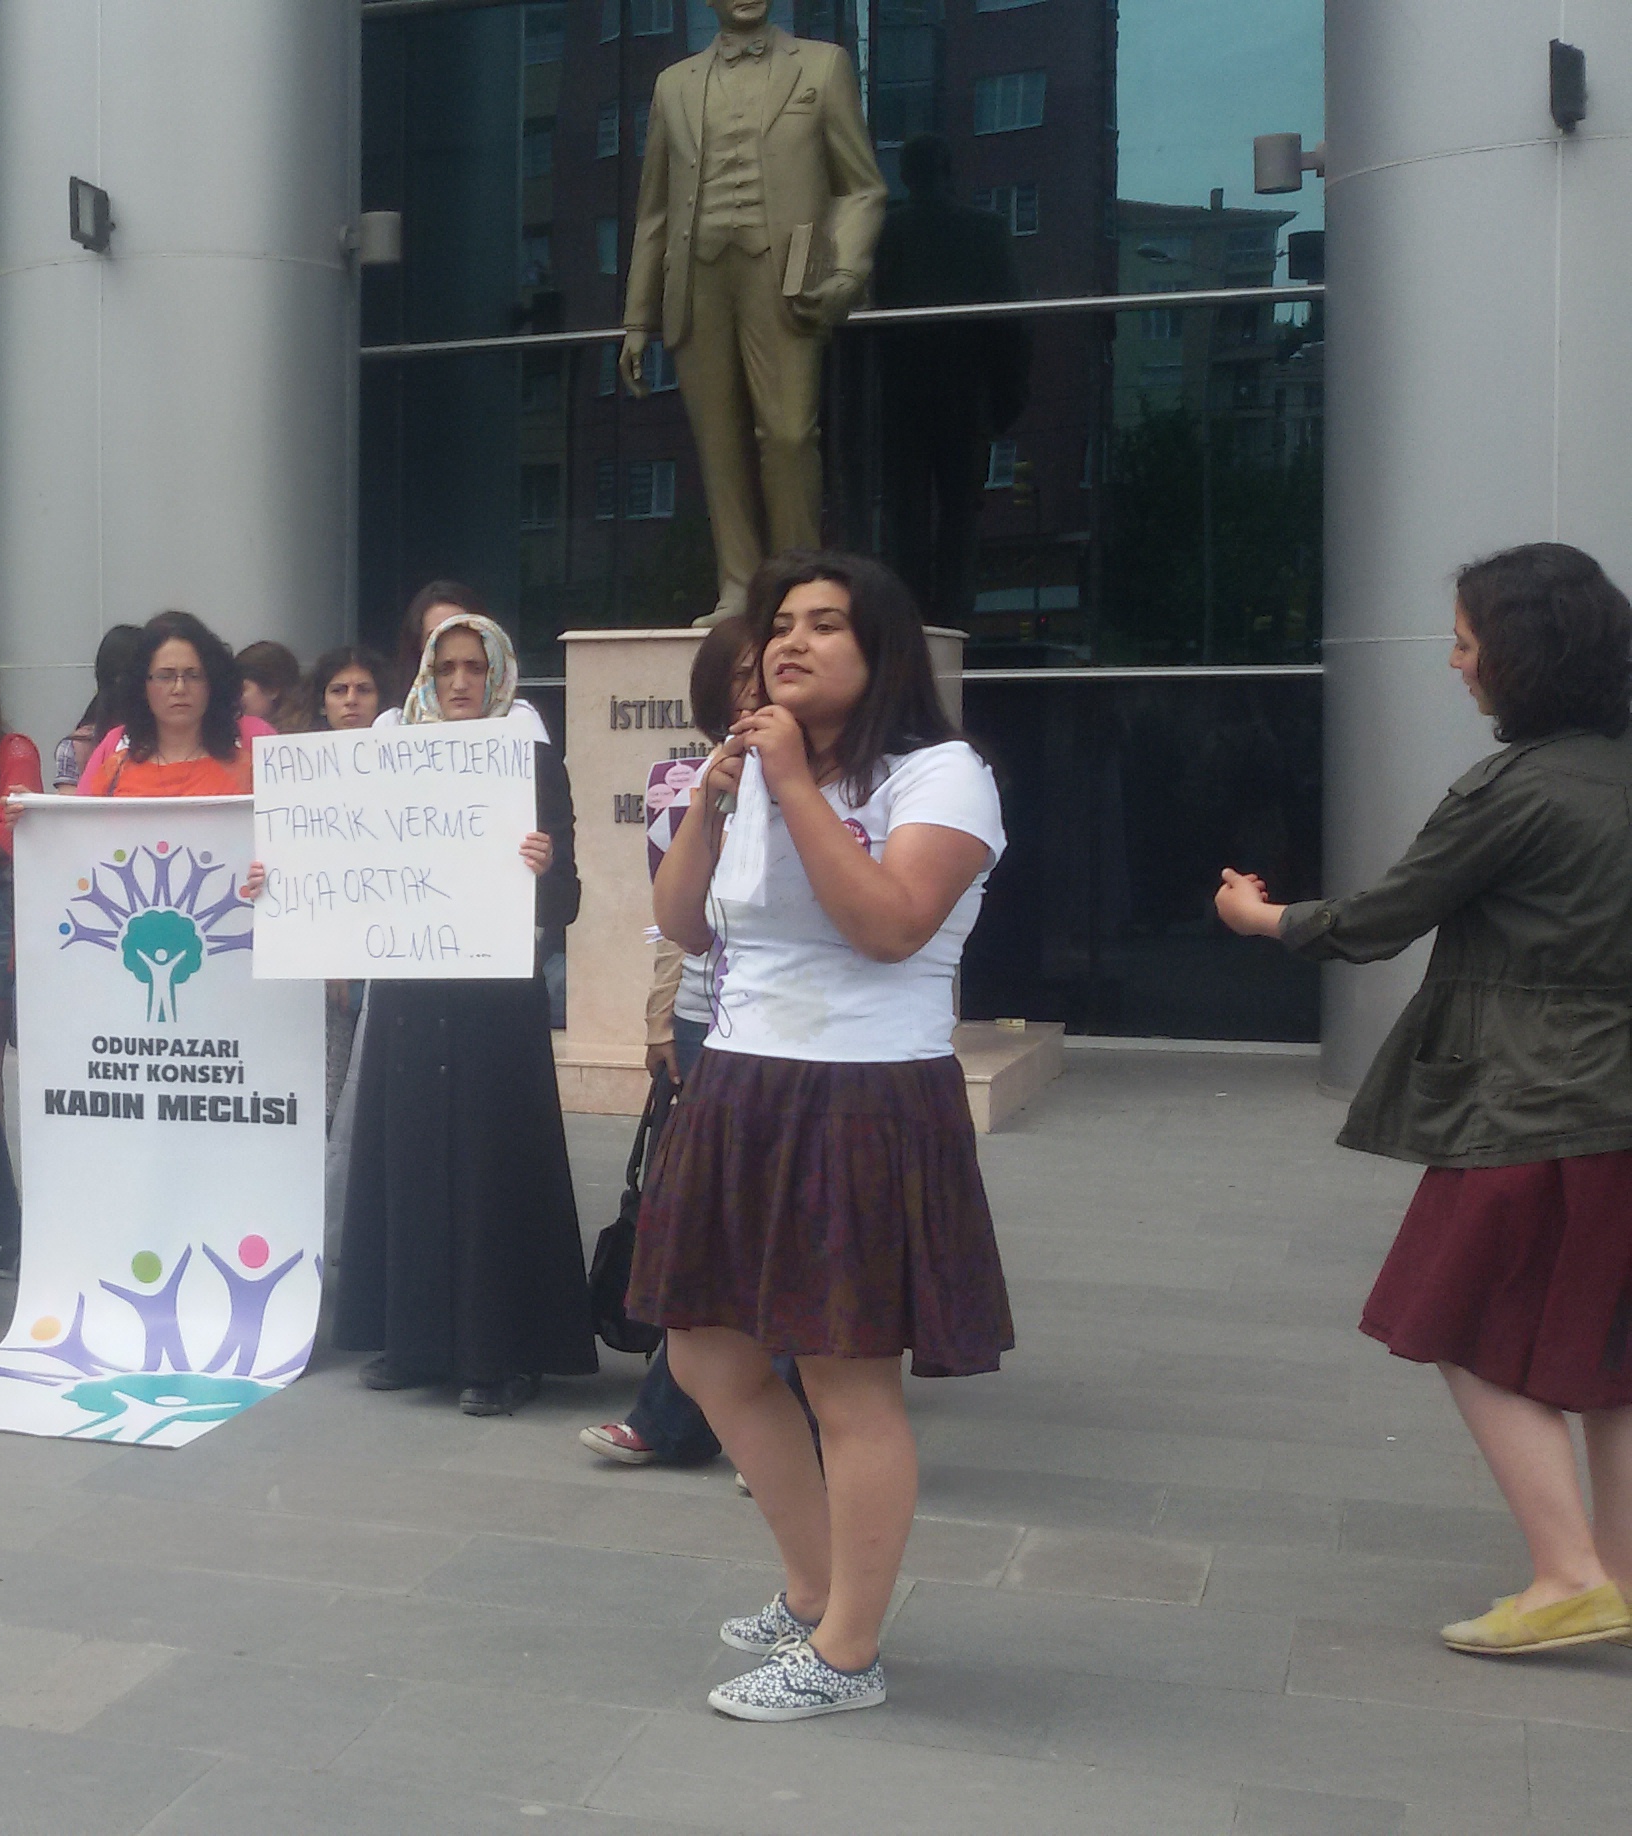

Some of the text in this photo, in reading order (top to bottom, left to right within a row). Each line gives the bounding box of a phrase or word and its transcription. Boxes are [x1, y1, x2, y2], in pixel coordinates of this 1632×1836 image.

[610, 695, 695, 730] İSTİKL
[263, 735, 533, 784] KADIN CİNAYETLERİNE
[255, 803, 490, 843] TAHRİK VERME
[266, 867, 452, 922] SUÇA ORTAK
[91, 1036, 239, 1058] ODUNPAZARI
[88, 1060, 244, 1084] KENT KONSEYİ
[45, 1089, 297, 1125] KADIN MECLİSİ
